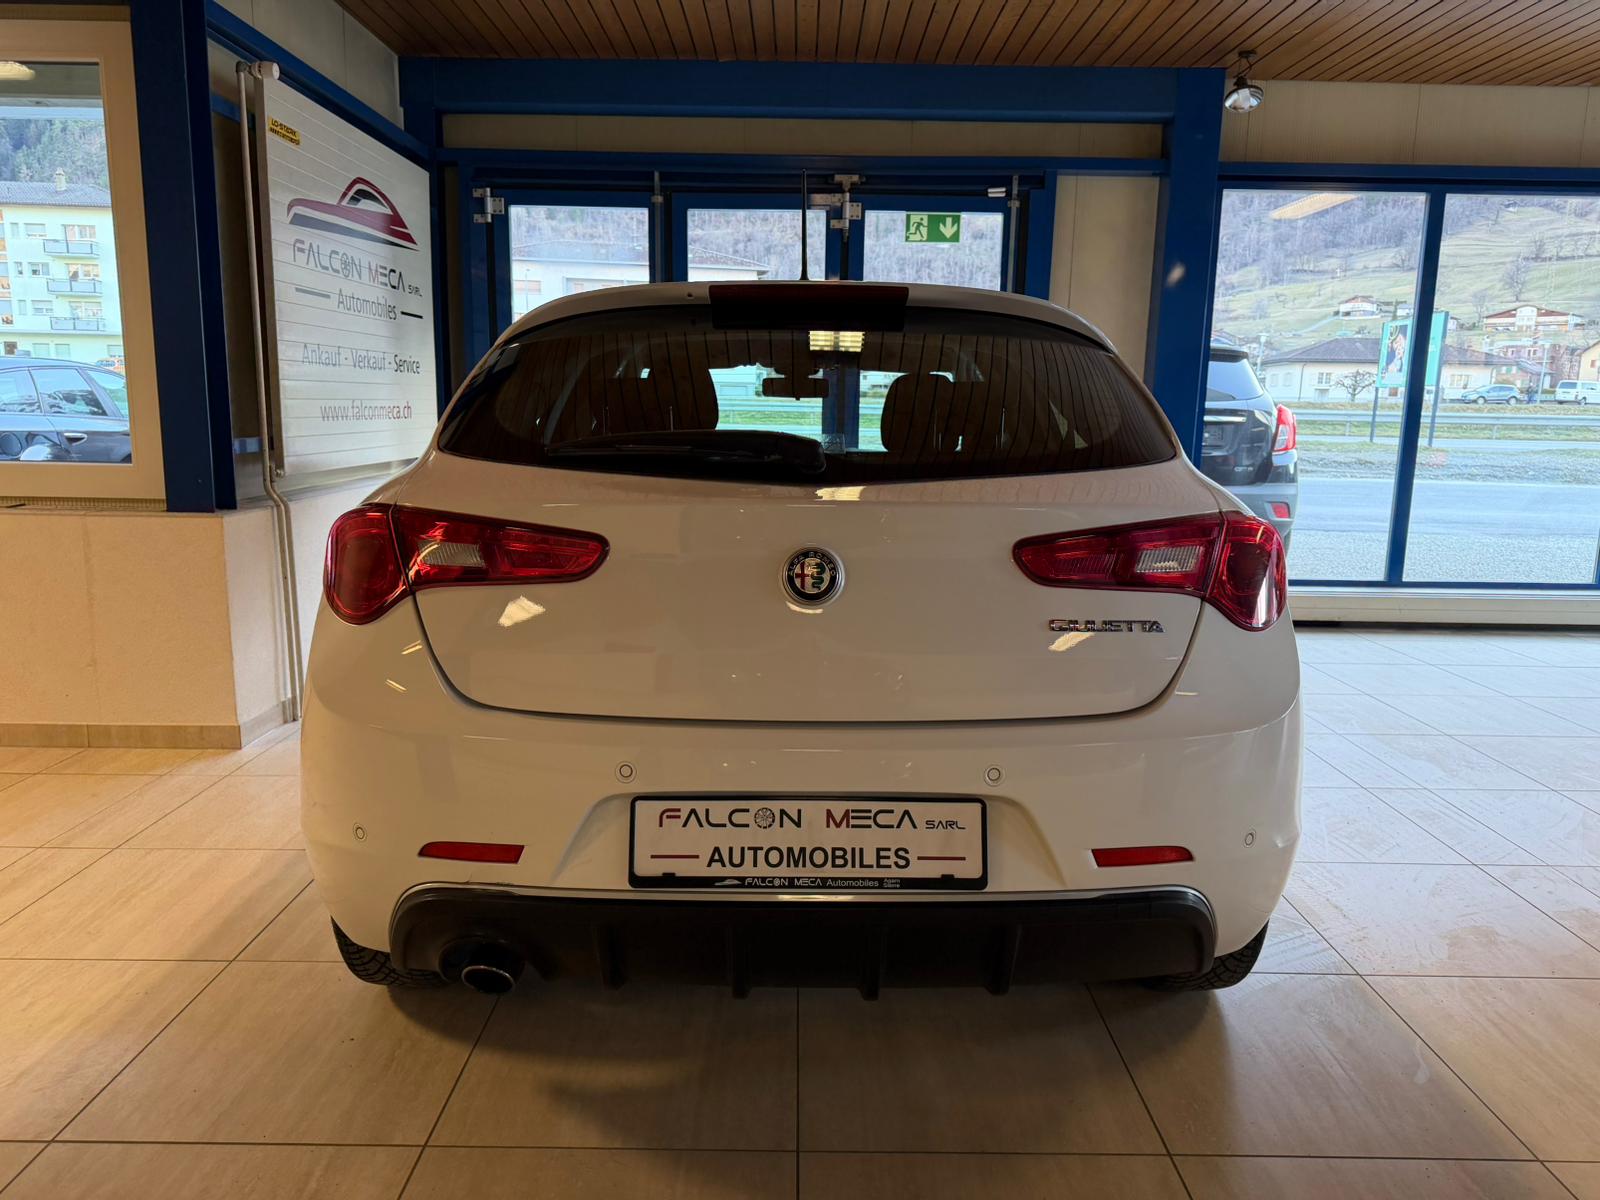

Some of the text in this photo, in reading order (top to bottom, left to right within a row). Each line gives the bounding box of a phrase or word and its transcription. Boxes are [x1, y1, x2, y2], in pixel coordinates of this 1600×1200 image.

[293, 238, 362, 280] FALCON
[368, 261, 406, 293] MECA
[337, 288, 397, 320] Automobiles
[302, 343, 342, 368] Ankauf
[350, 349, 387, 369] Verkauf
[393, 354, 421, 374] Service
[320, 399, 412, 422] www.falconmeca.ch
[1048, 619, 1164, 632] GIULIETTA
[659, 807, 966, 830] FALCON MECA SARL
[706, 846, 911, 869] AUTOMOBILES
[745, 877, 788, 886] FALCON
[794, 877, 822, 886] MECA
[826, 878, 879, 887] Automobiles
